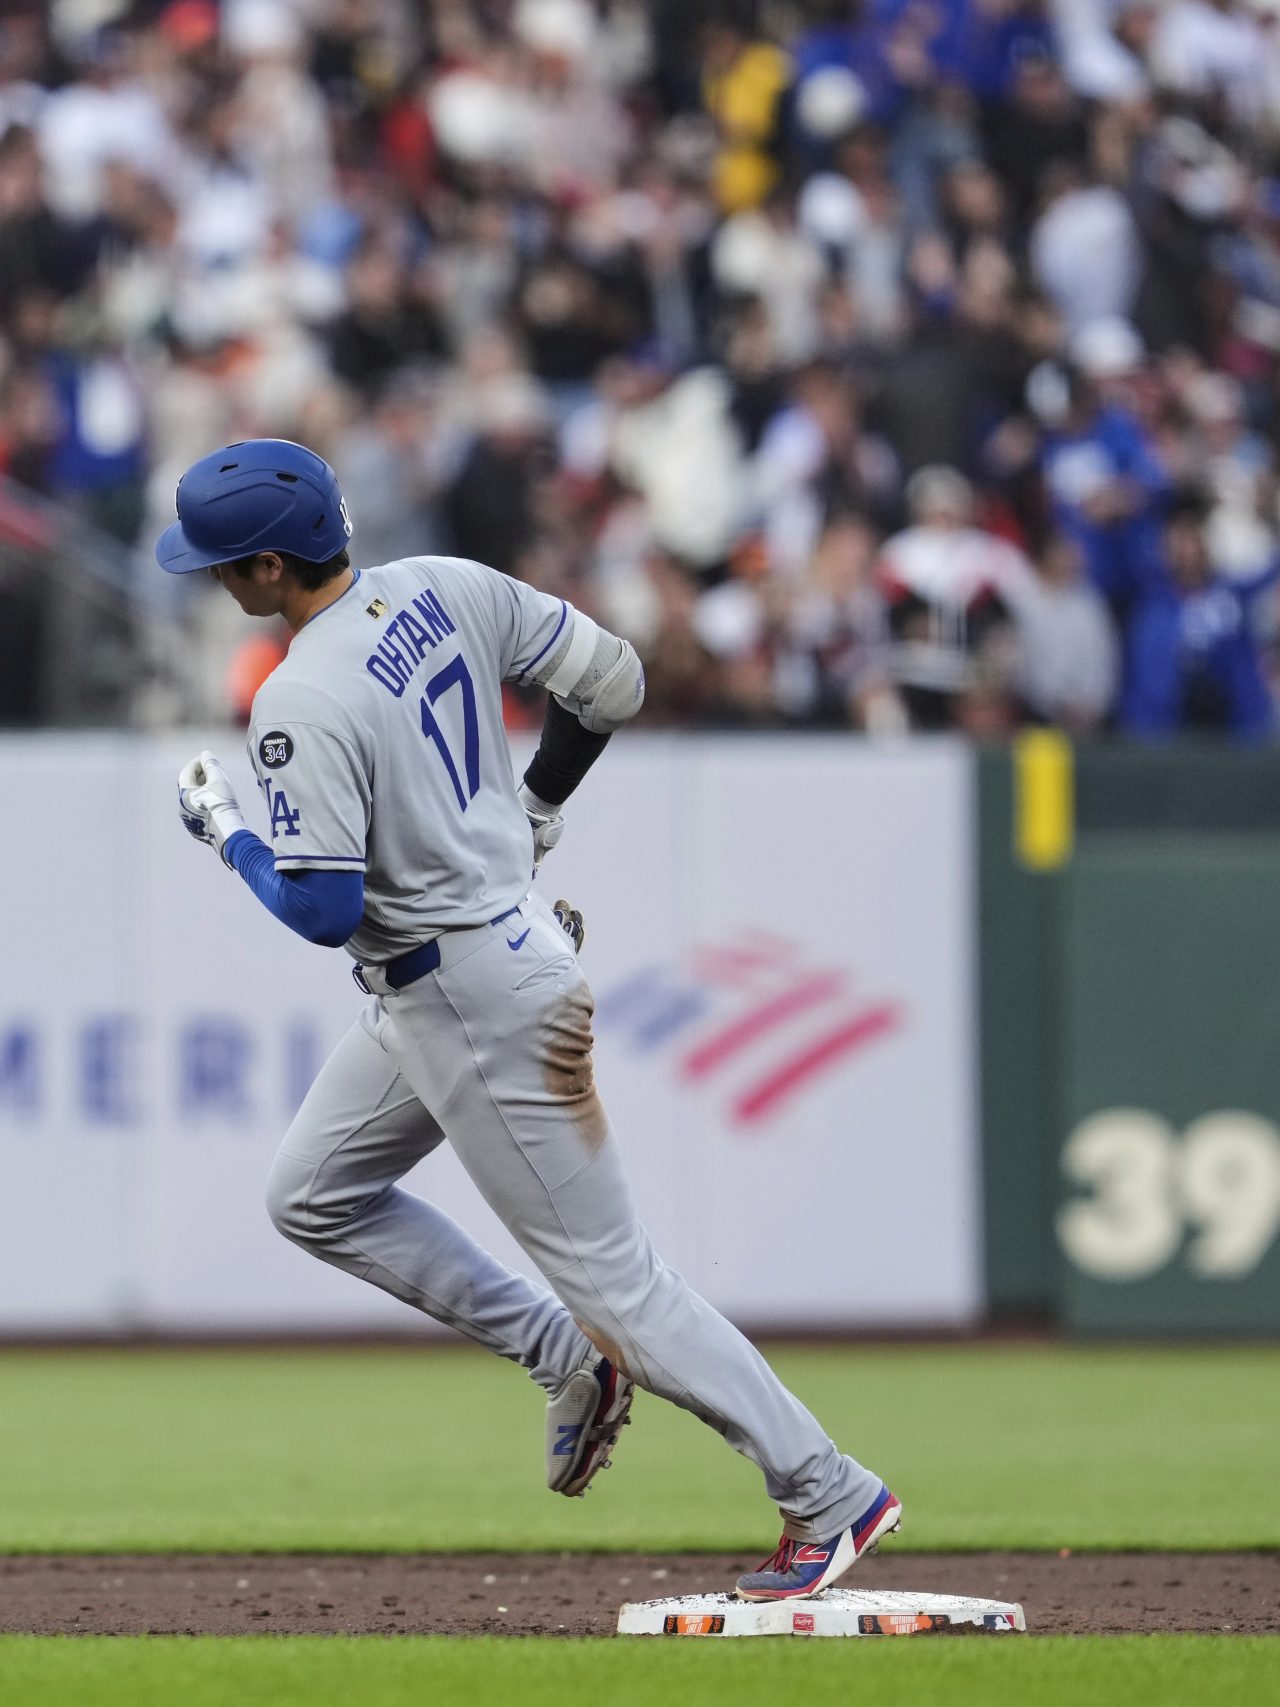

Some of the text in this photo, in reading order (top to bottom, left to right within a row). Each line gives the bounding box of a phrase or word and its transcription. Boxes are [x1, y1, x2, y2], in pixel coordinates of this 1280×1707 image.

[366, 588, 457, 698] OHTANI
[265, 744, 286, 762] 34
[420, 652, 480, 813] 17
[896, 1624, 911, 1634] LIKE
